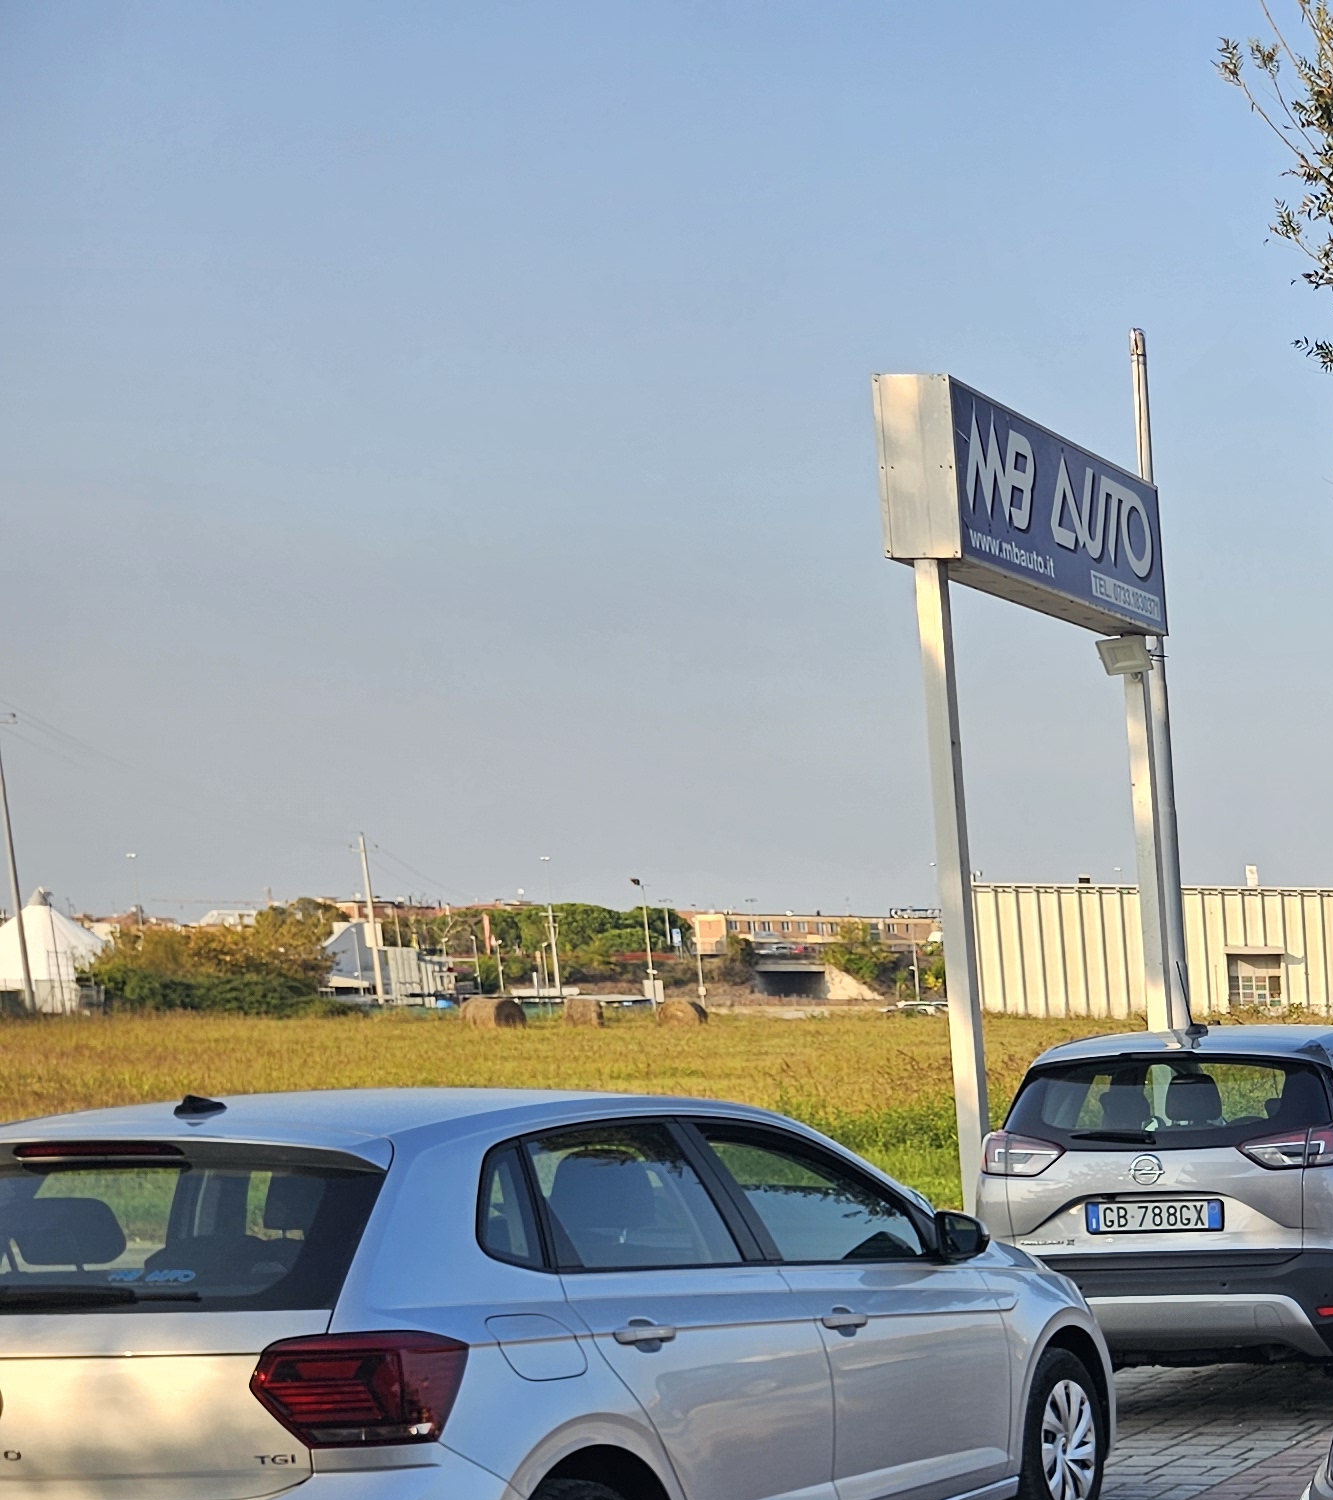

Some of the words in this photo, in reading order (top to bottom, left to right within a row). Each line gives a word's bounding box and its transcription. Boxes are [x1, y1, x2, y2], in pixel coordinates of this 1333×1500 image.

[966, 410, 1035, 530] MB
[1050, 454, 1153, 578] AUTO
[968, 527, 1056, 579] www.mbauto.it
[1102, 1206, 1129, 1228] GB
[1136, 1204, 1205, 1228] 788GX
[254, 1453, 297, 1465] TGI
